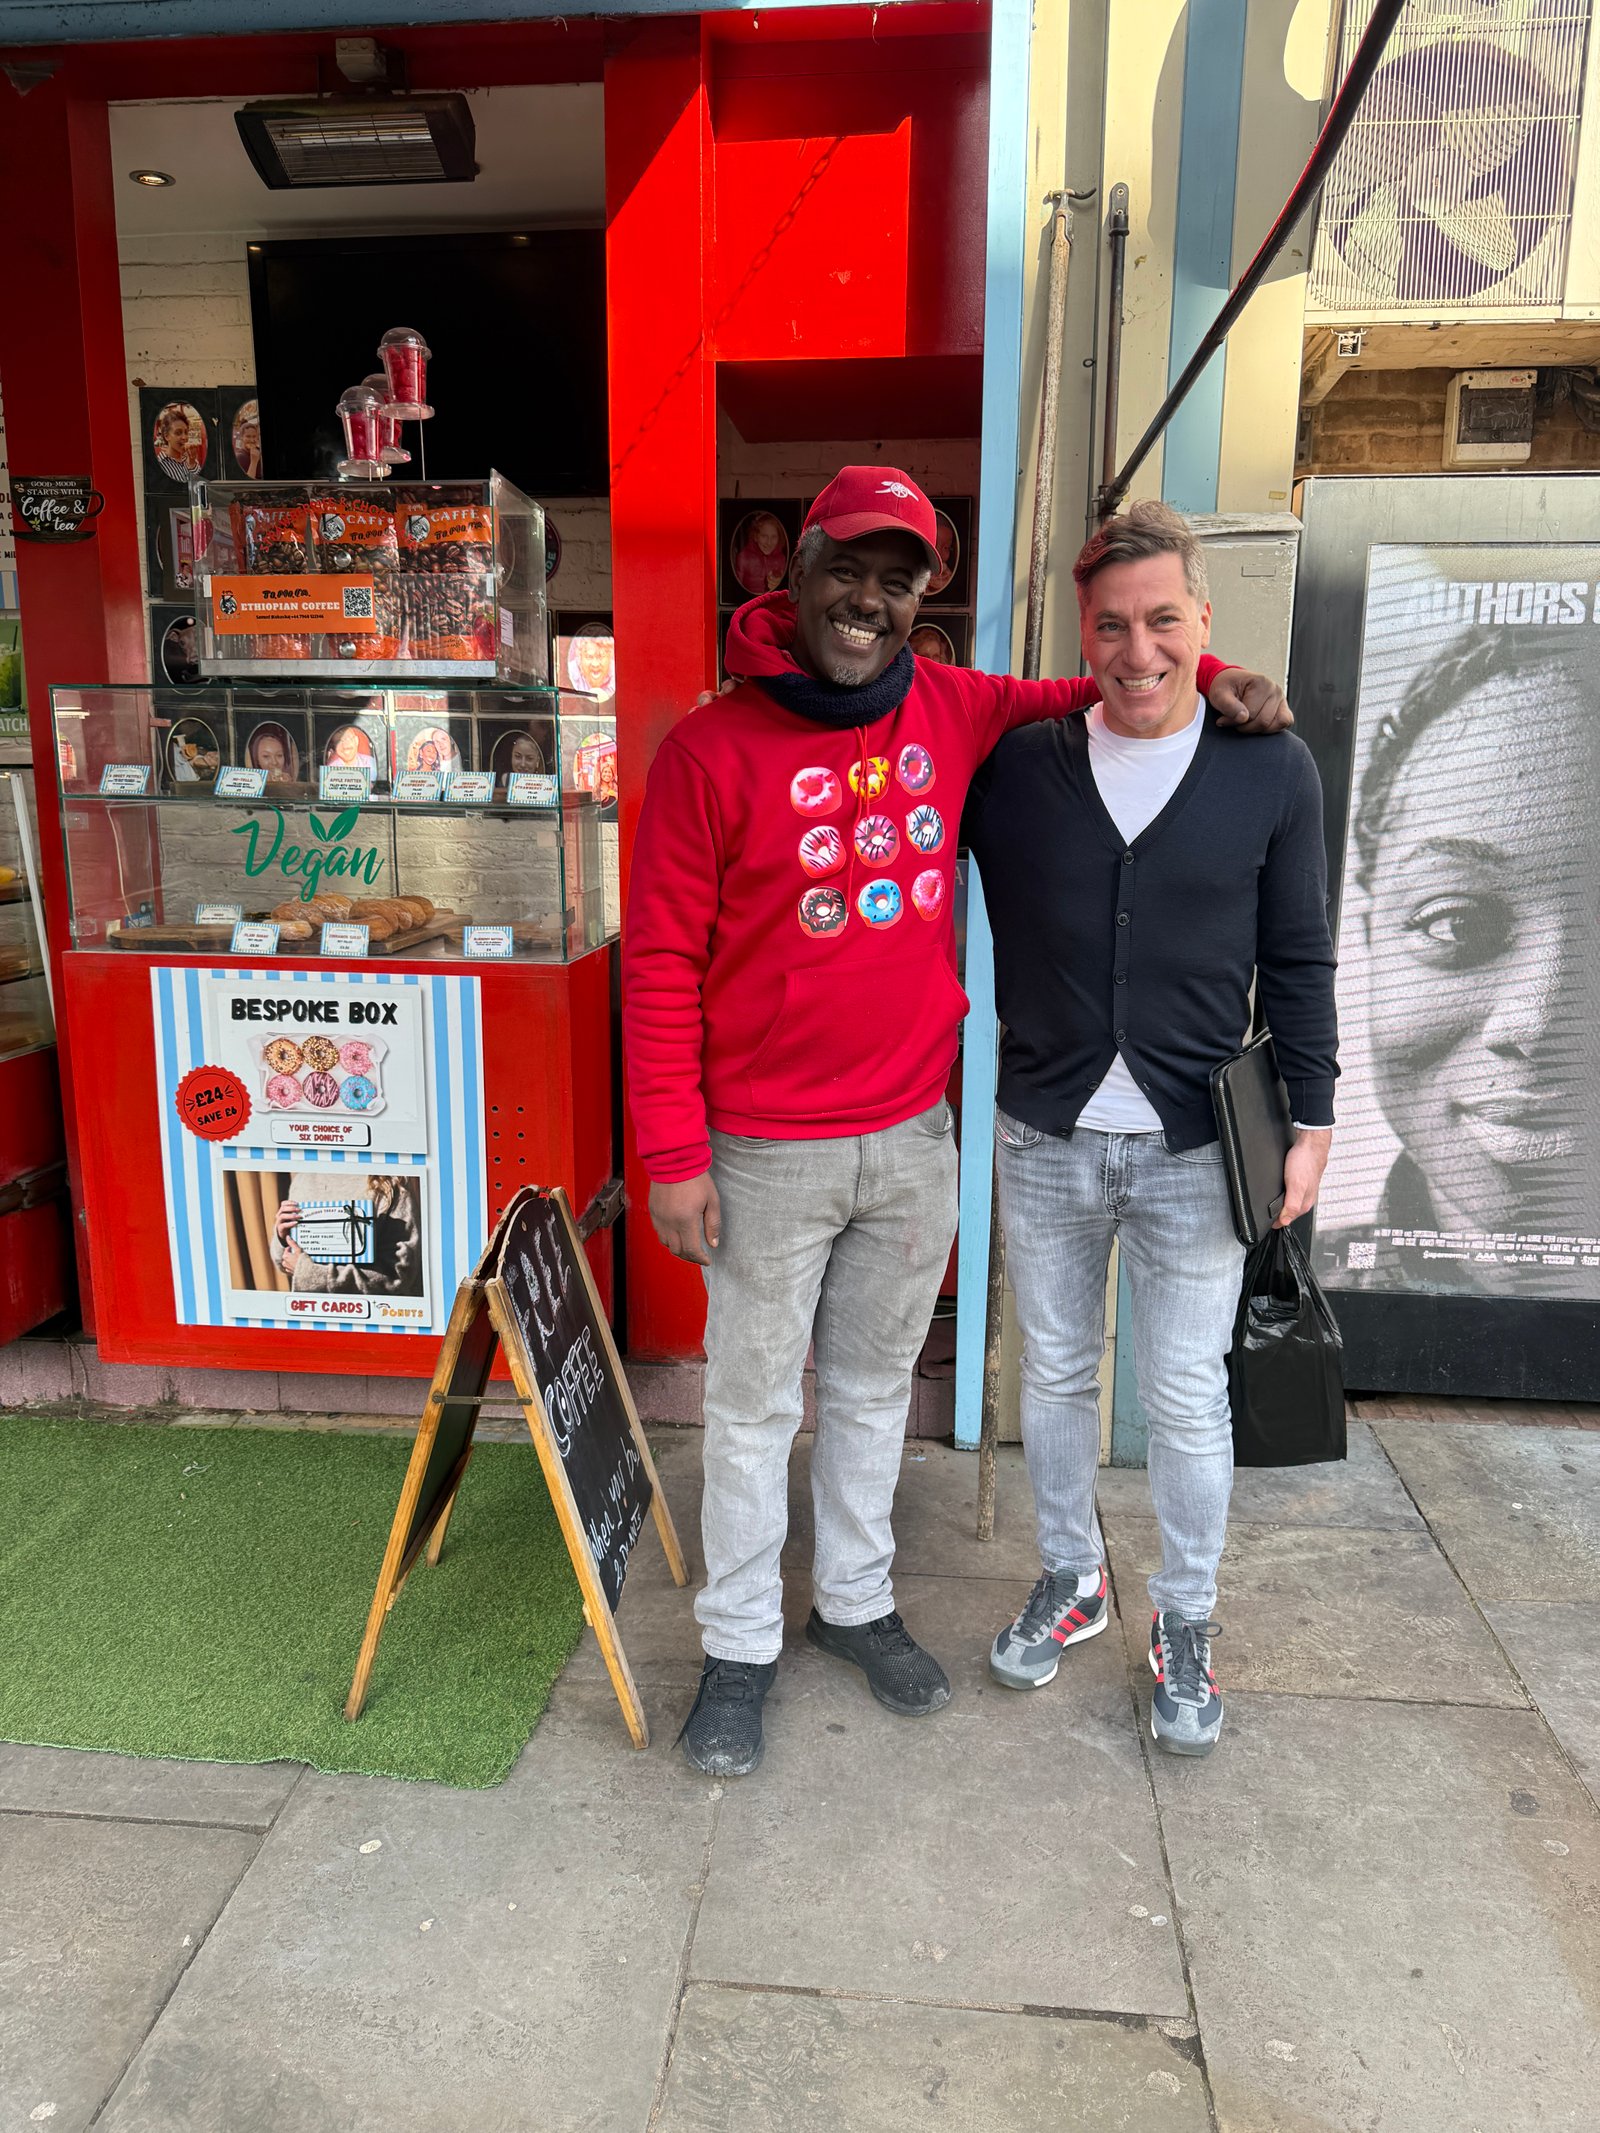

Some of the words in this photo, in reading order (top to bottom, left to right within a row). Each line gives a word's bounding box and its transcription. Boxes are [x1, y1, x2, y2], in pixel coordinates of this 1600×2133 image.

[21, 495, 70, 522] Coffee
[73, 499, 86, 514] &
[430, 508, 479, 523] CAFFE
[52, 517, 77, 531] tea
[240, 601, 299, 611] ETHIOPIAN
[302, 601, 340, 610] COFFEE
[230, 804, 385, 902] Vegan
[231, 998, 340, 1023] BESPOKE
[349, 1001, 398, 1025] BOX
[196, 1086, 224, 1108] £24
[197, 1110, 223, 1126] SAVE
[225, 1106, 238, 1117] £6
[289, 1125, 311, 1133] YOUR
[312, 1125, 340, 1133] CHOICE
[343, 1126, 353, 1134] OF
[299, 1133, 311, 1141] SIX
[314, 1134, 345, 1142] DONUTS
[1422, 1250, 1470, 1260] Supernormal
[1503, 1253, 1518, 1263] ugly
[505, 1211, 572, 1375] FREE
[290, 1300, 317, 1312] GIFT
[321, 1301, 364, 1314] CARDS
[382, 1308, 424, 1319] DONUTS
[544, 1325, 604, 1458] COFFEE
[608, 1460, 626, 1530] you
[614, 1559, 623, 1588] 2
